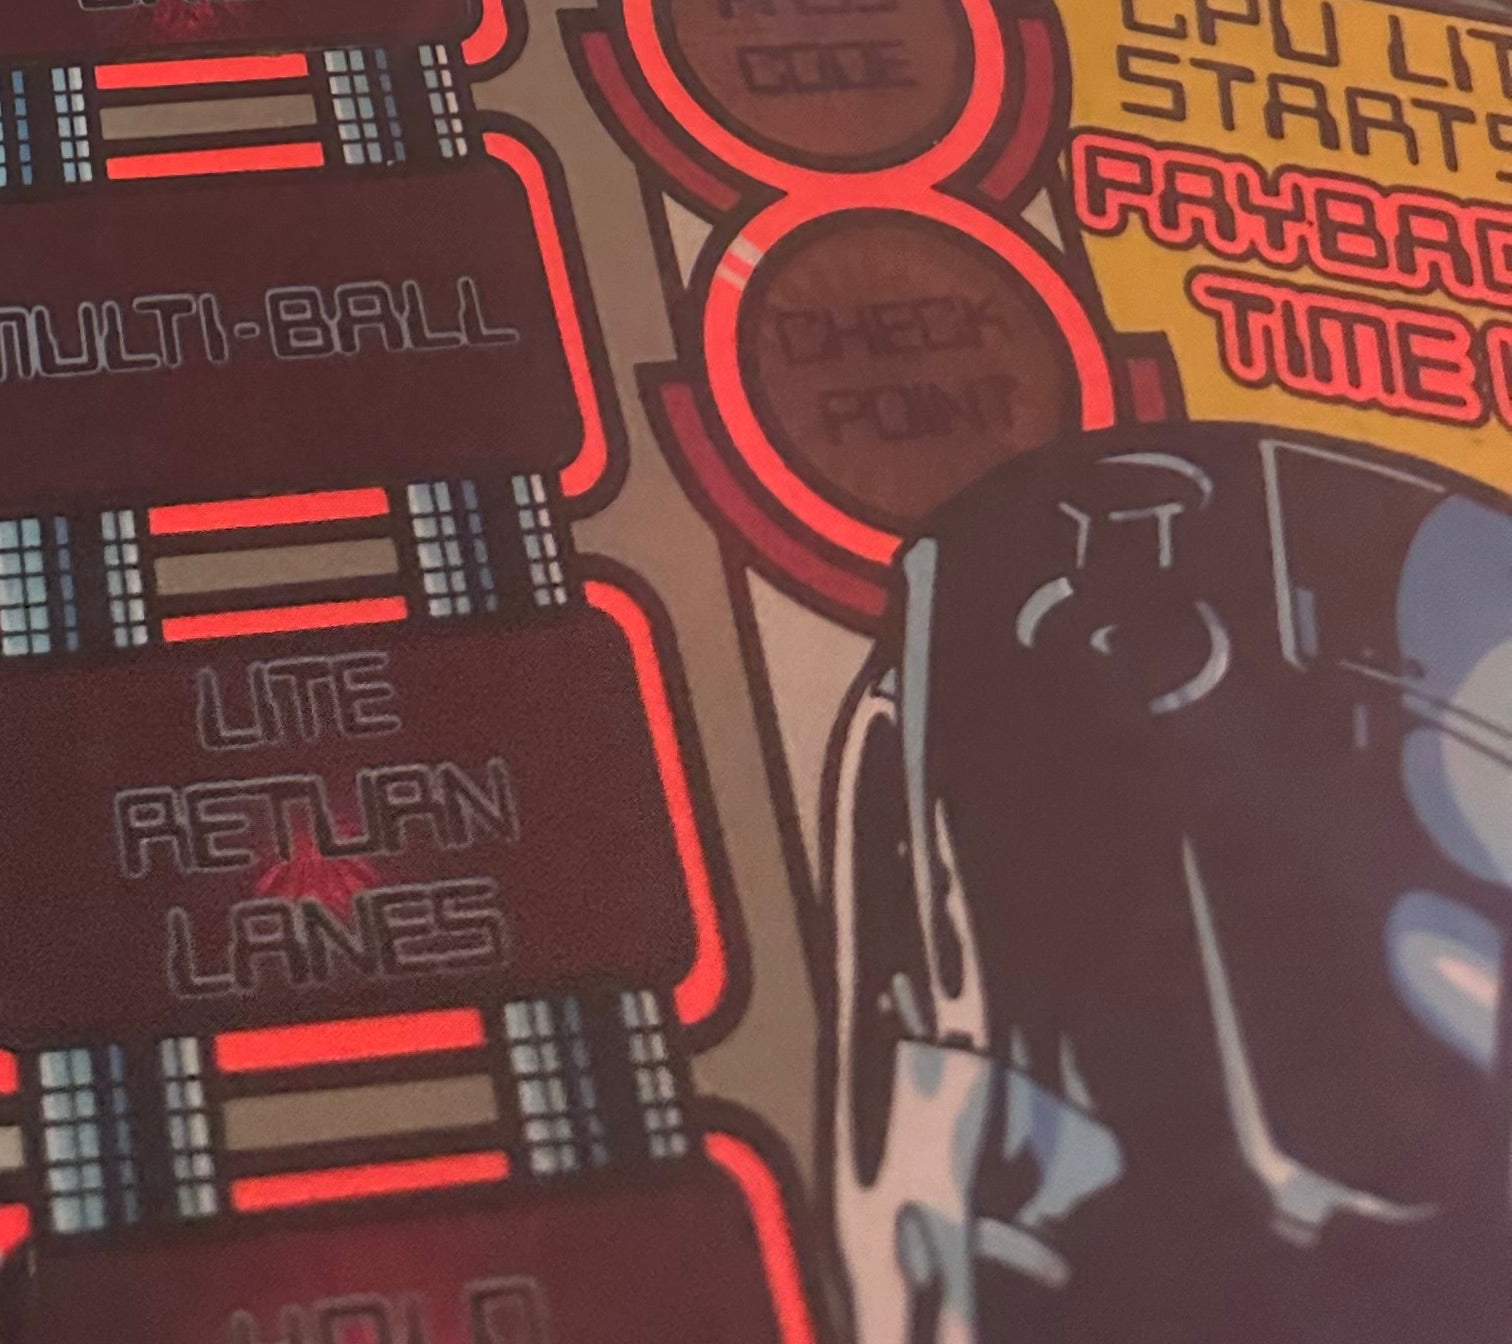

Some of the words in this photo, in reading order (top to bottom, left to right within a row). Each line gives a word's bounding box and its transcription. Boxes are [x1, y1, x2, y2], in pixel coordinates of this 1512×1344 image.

[738, 41, 917, 97] CODE
[774, 294, 1008, 368] CHECK
[1189, 270, 1483, 427] TIME
[820, 378, 1021, 447] POINT
[196, 650, 403, 752] LITE
[113, 758, 521, 880] RETURN
[167, 878, 514, 1000] LANES
